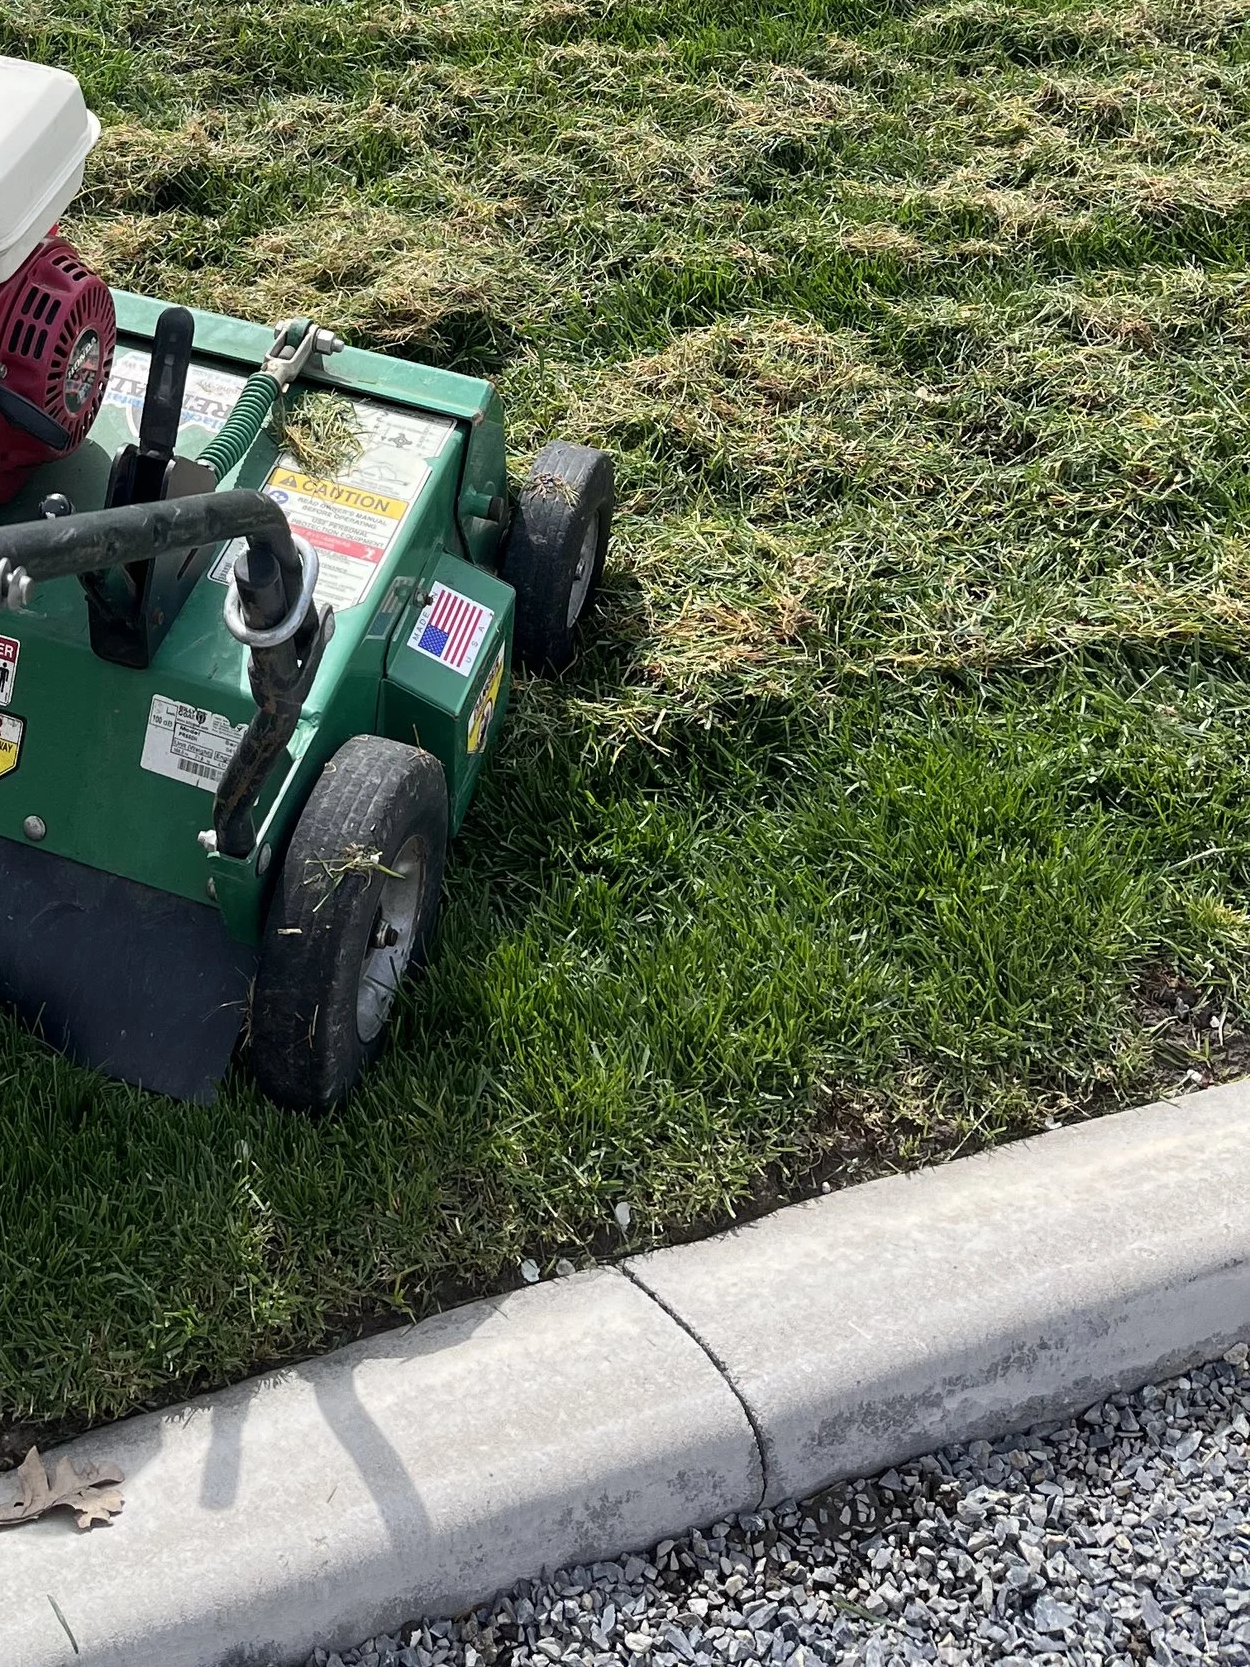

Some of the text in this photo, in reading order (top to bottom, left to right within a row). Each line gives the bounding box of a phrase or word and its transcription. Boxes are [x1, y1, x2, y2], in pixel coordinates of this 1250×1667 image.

[67, 337, 97, 379] HONDA
[302, 480, 390, 512] CAUTION
[297, 497, 318, 507] READ
[355, 512, 387, 526] MANUAL
[302, 505, 377, 530] BEFORE OPERATING
[290, 518, 340, 537] PROTECTION
[340, 532, 385, 548] EQUIPMENT
[311, 517, 369, 538] USE PERSONAL
[413, 611, 430, 641] MADE
[179, 725, 201, 736] Model
